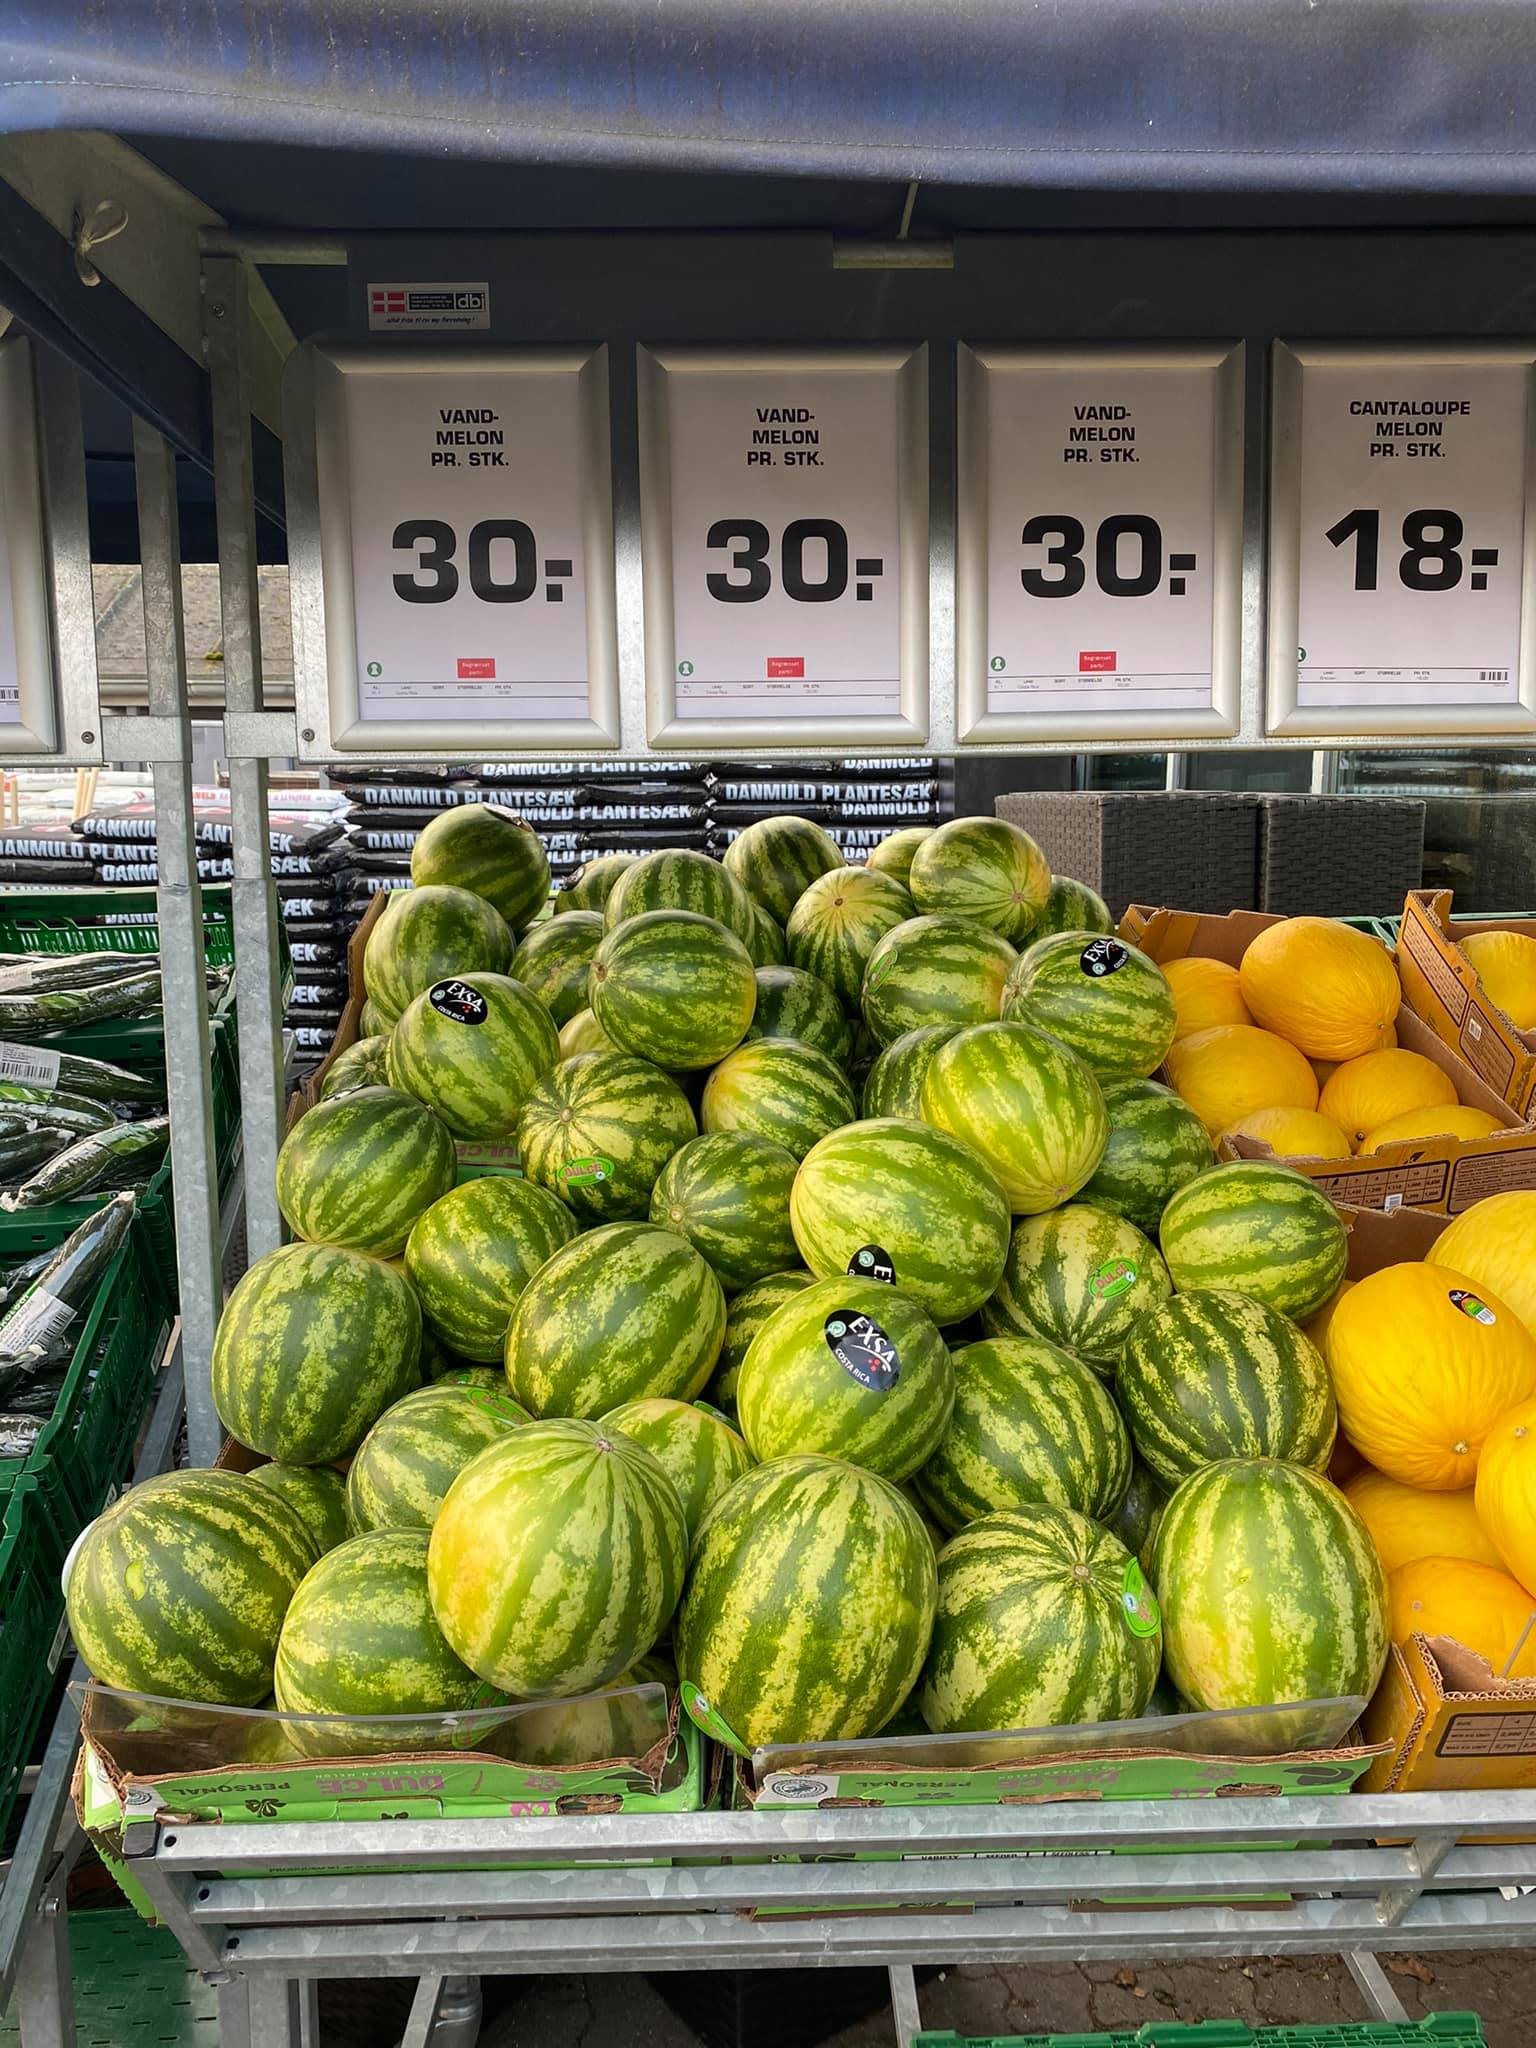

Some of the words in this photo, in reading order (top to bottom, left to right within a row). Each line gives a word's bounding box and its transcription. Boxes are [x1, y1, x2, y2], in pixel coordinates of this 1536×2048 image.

[756, 408, 816, 424] VAND-
[1073, 406, 1132, 421] VAND-
[1349, 400, 1471, 416] CANTALOUPE
[439, 409, 500, 425] VAND-
[752, 429, 819, 445] MELON
[1069, 426, 1136, 442] MELON
[1375, 421, 1443, 437] MELON
[436, 430, 504, 446] MELON
[747, 450, 777, 466] PR.
[783, 450, 824, 466] STK.
[1063, 447, 1093, 463] PR.
[1100, 447, 1140, 463] STK.
[1370, 442, 1399, 458] PR.
[1406, 442, 1446, 458] STK.
[431, 451, 462, 467] PR.
[468, 451, 510, 467] STK.
[365, 788, 459, 806] DANMULD
[464, 790, 576, 807] PLANTESÆK
[726, 783, 816, 800] DANMULD
[822, 783, 931, 802] PLANTESÆK
[580, 804, 693, 820] PLANTESÆK
[848, 1316, 896, 1364] EXSA
[835, 1348, 855, 1372] COSTA
[852, 1367, 871, 1384] RICA
[171, 1782, 291, 1796] PERSONAL
[319, 1775, 445, 1796] DULCE
[856, 1780, 972, 1788] PERSONAL
